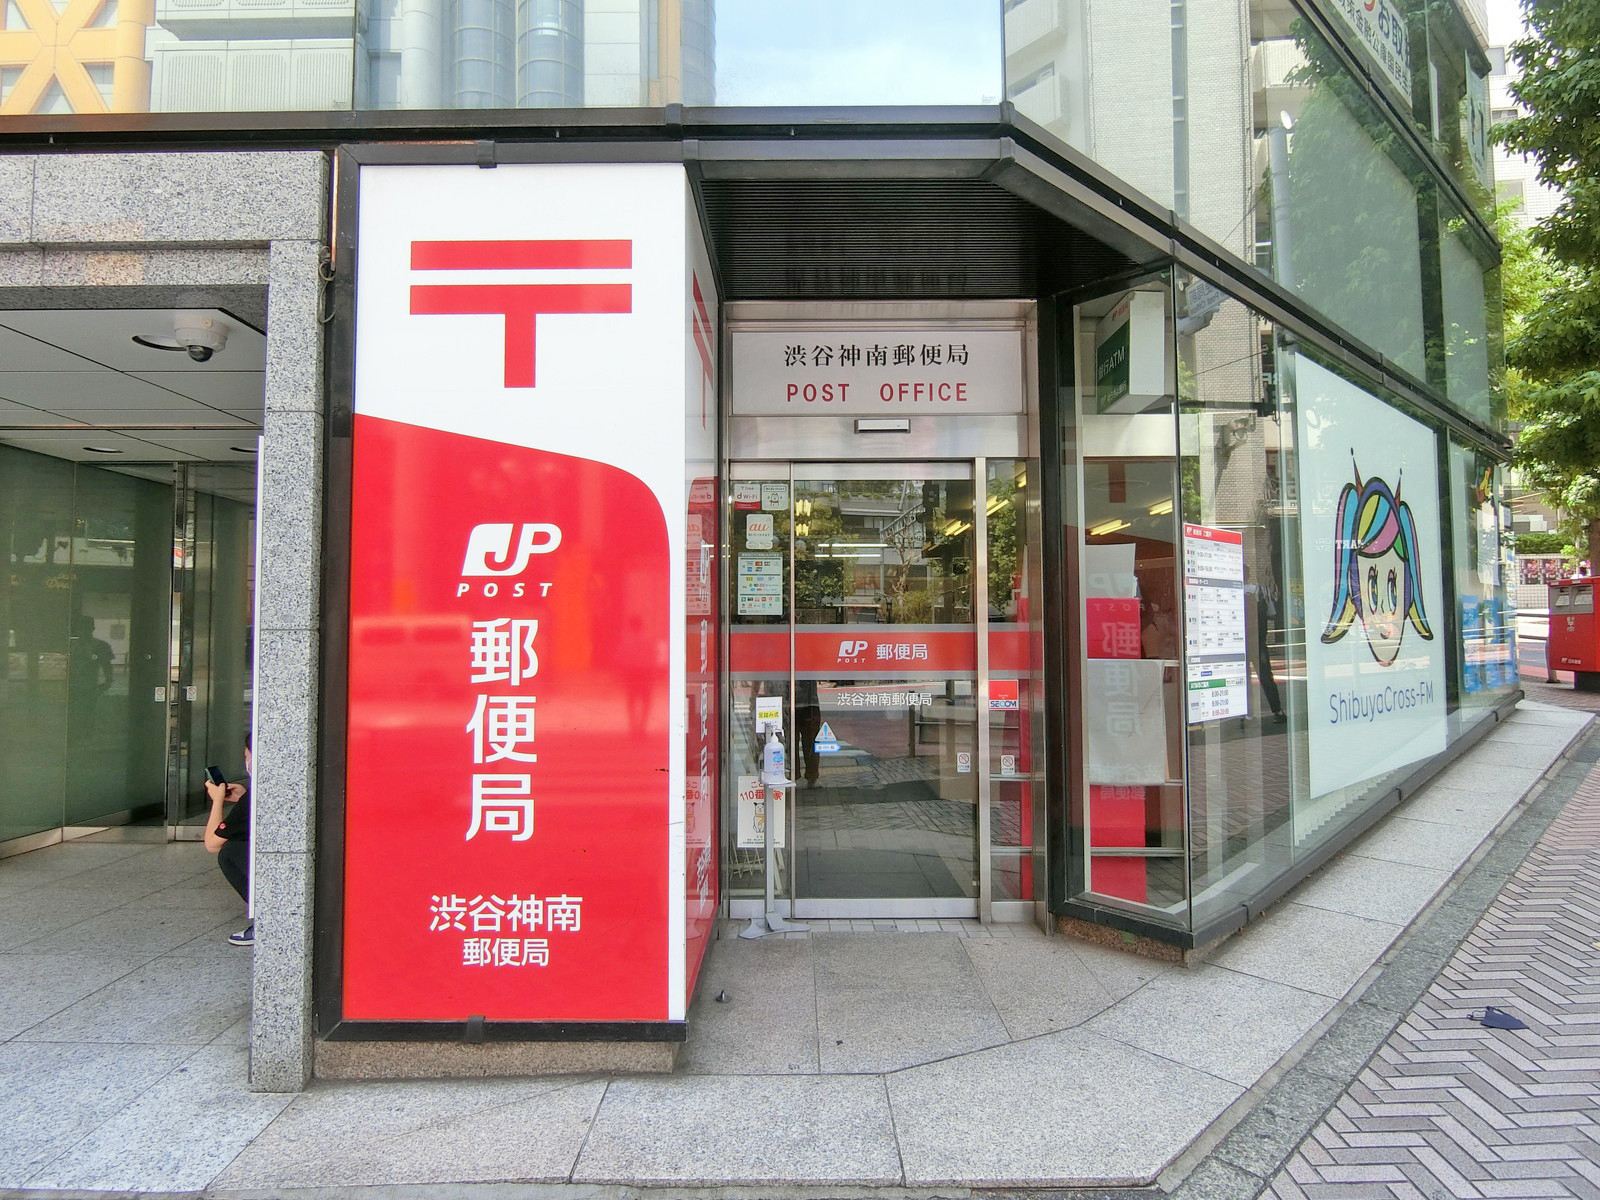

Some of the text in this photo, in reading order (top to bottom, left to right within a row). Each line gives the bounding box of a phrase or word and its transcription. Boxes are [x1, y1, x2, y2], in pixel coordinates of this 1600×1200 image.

[783, 343, 970, 367] 渋谷神南郵便局
[787, 383, 968, 402] POST OFFICE
[749, 523, 769, 532] au
[461, 523, 563, 576] JP
[457, 582, 555, 597] POST
[876, 643, 928, 661] 郵便局
[837, 692, 932, 707] 渋谷神南郵便局
[990, 700, 1017, 708] SECOM
[1329, 680, 1434, 724] ShibuyaCross-FM
[465, 617, 539, 842] 郵便局
[429, 894, 583, 932] 渋谷神南
[463, 937, 550, 967] 郵便局
